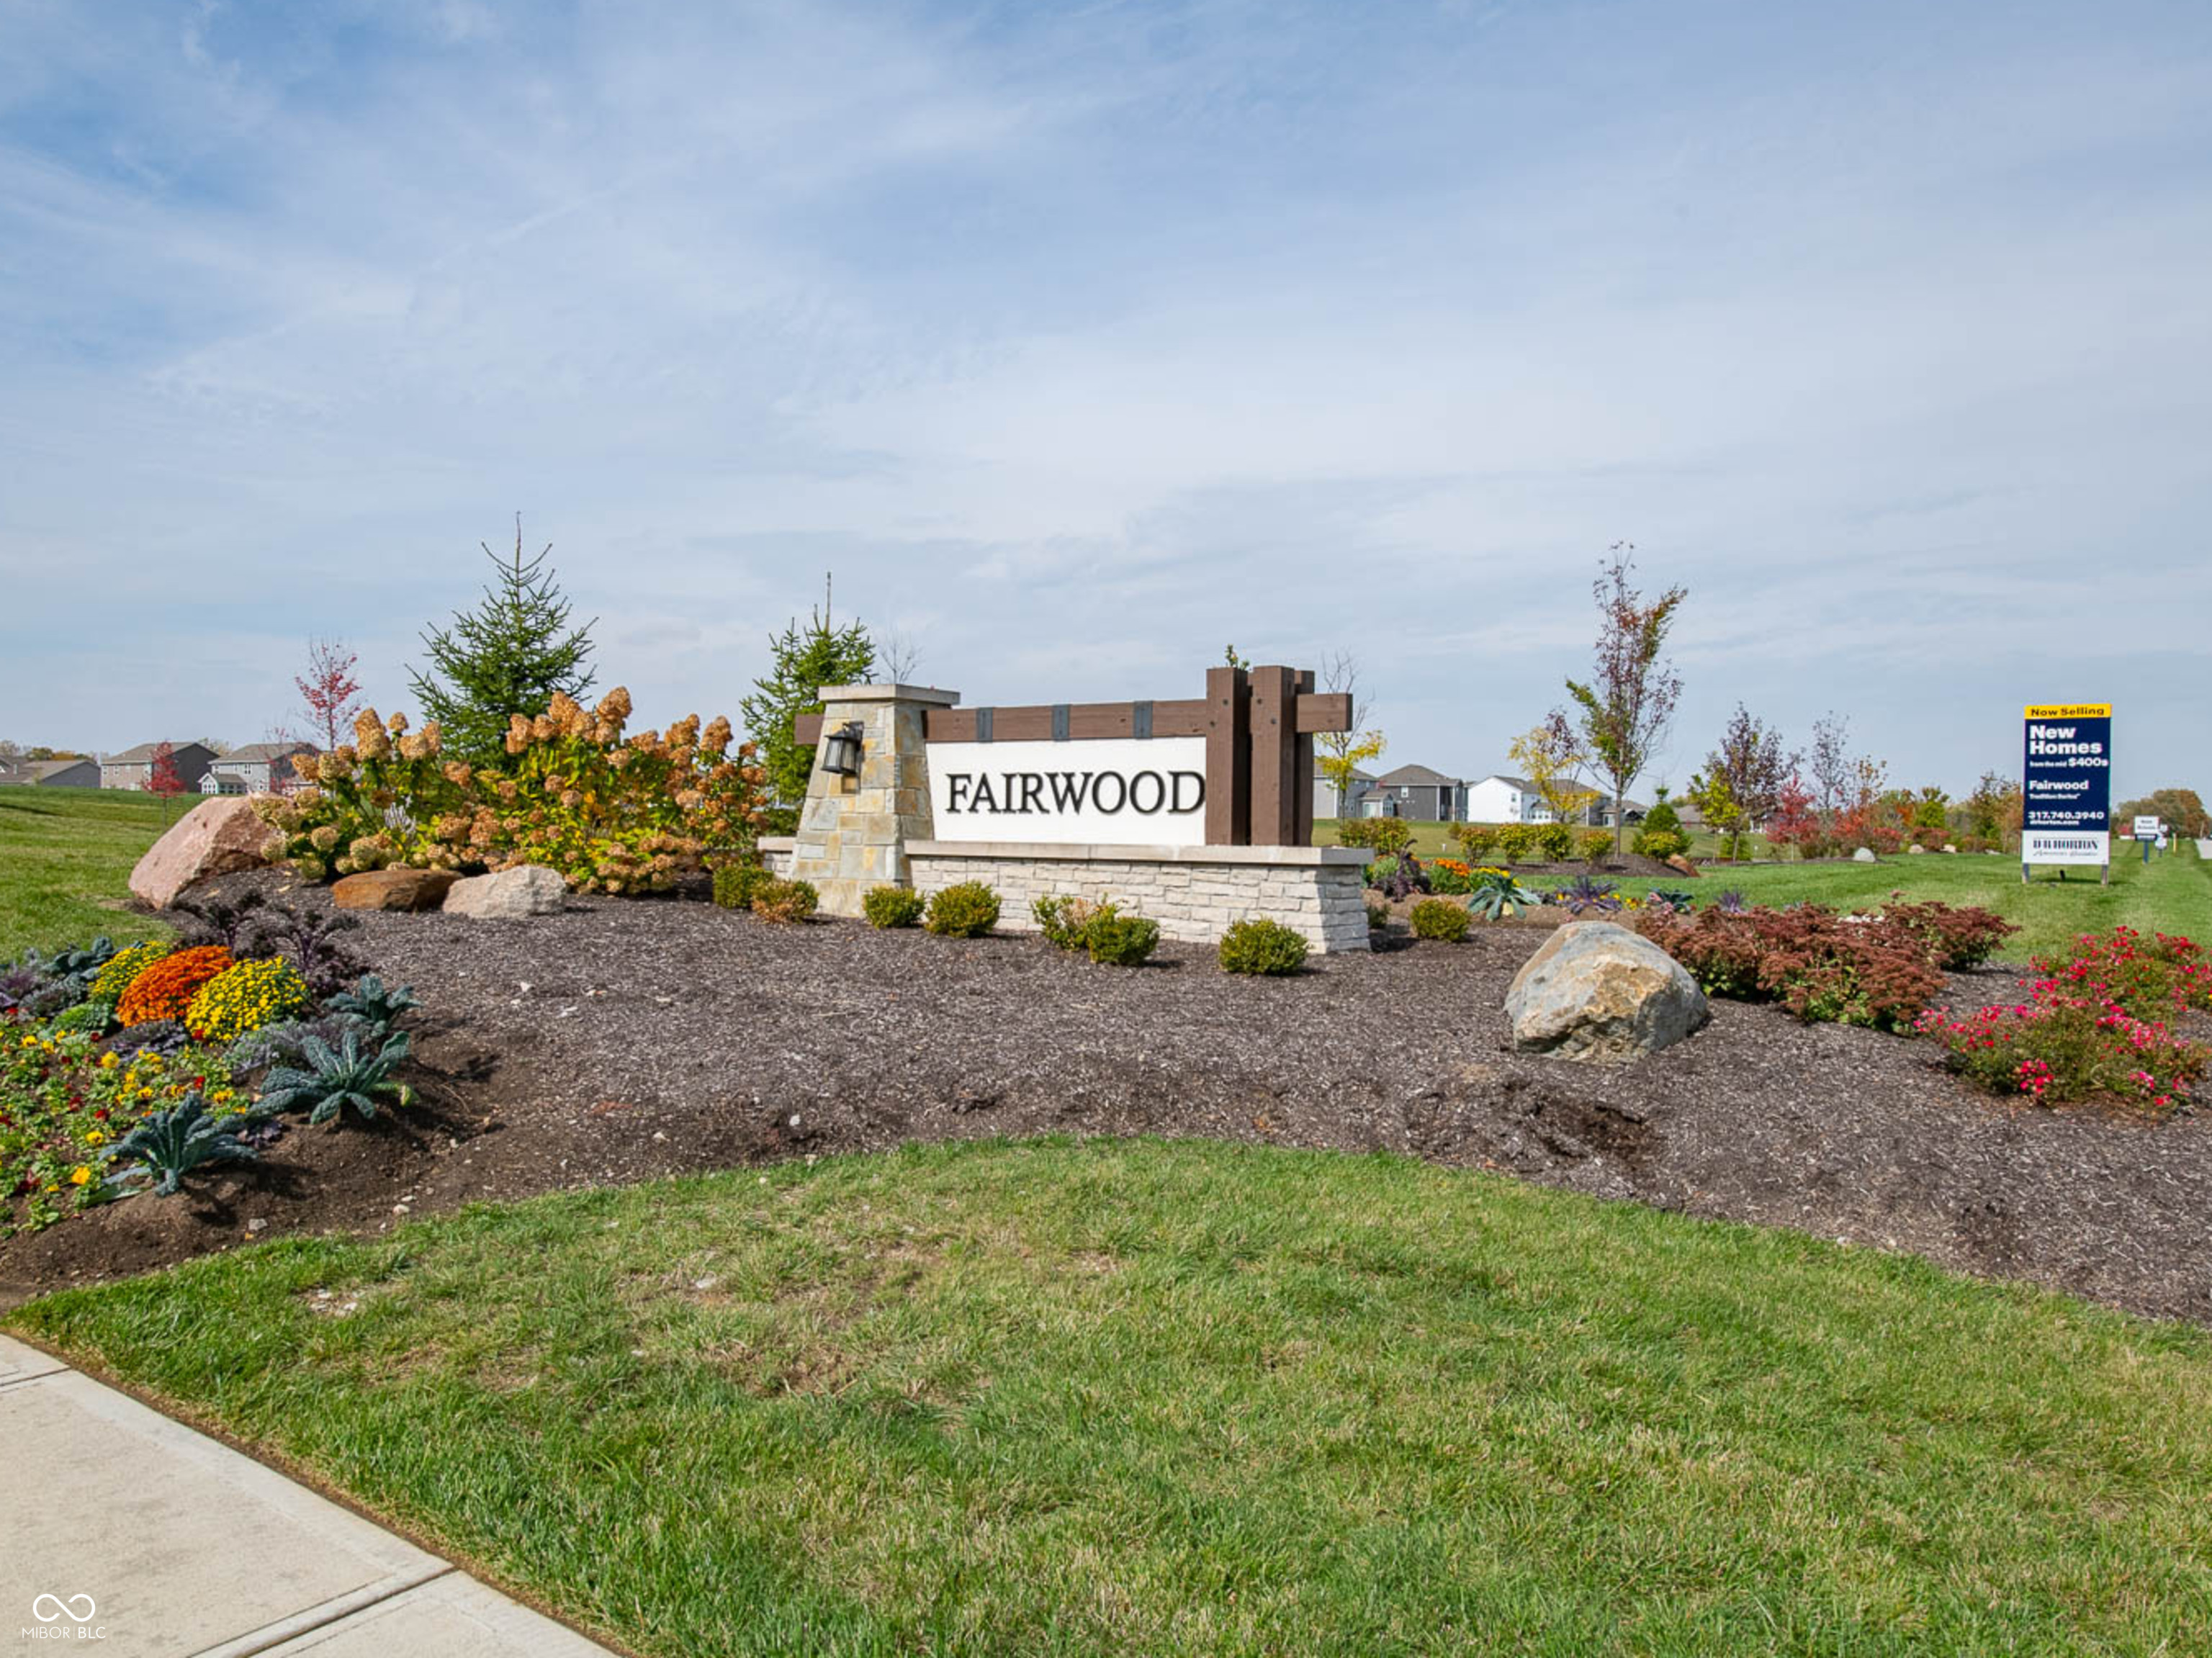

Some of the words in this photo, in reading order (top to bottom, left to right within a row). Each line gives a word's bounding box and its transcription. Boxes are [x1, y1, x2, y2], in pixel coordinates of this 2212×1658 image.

[2060, 707, 2105, 716] Selling
[2030, 724, 2076, 739] New
[2030, 740, 2102, 754] Homes
[2068, 757, 2109, 767] $400s
[2029, 780, 2089, 790] Fairwood
[945, 770, 1207, 816] FAIRWOOD
